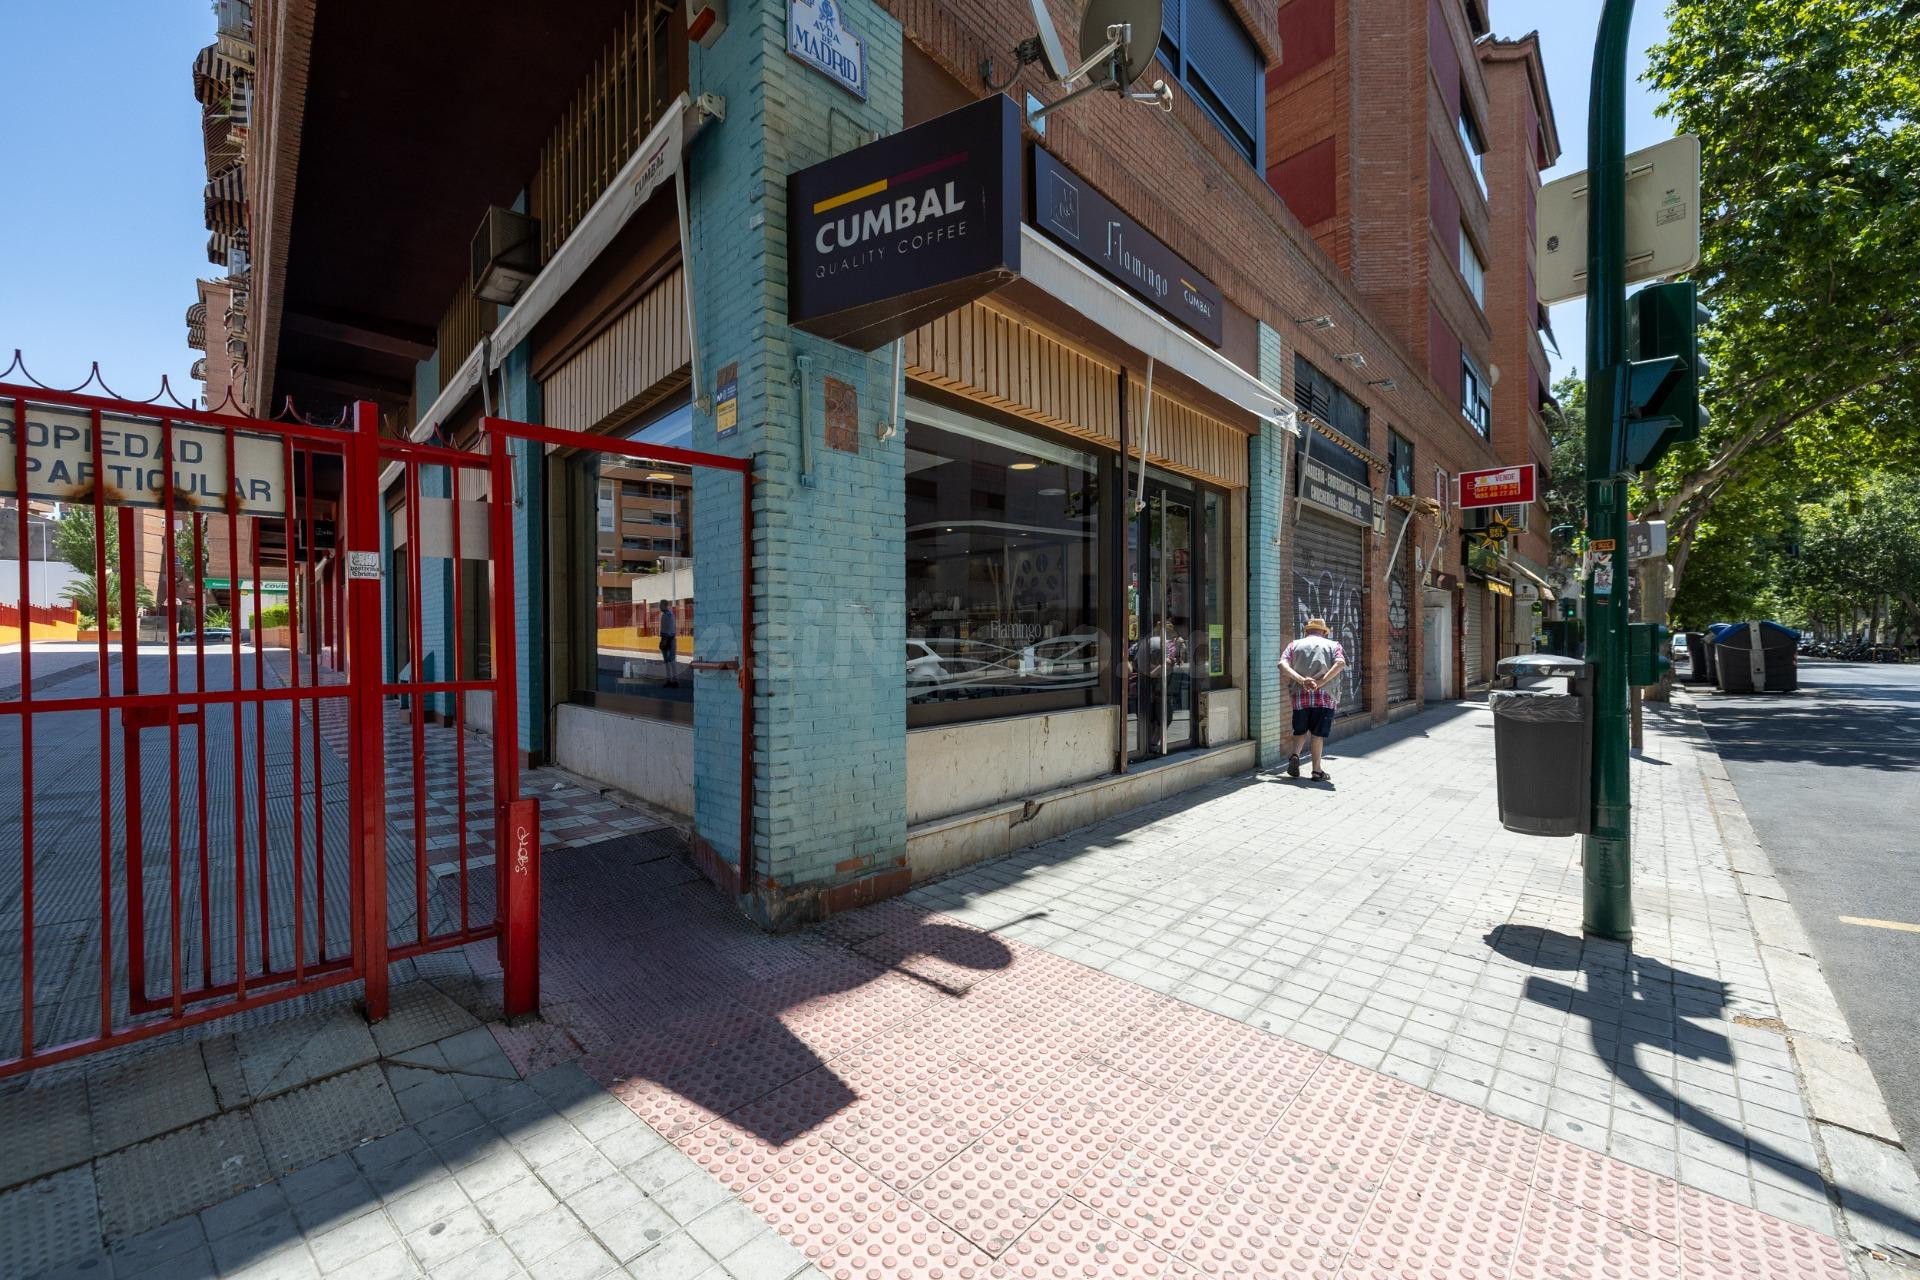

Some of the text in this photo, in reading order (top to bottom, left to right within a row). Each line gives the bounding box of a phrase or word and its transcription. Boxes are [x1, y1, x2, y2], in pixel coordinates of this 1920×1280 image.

[795, 24, 858, 83] MADRID
[822, 34, 833, 46] DE
[635, 152, 665, 197] CUMBAL
[815, 181, 966, 254] CUMBAL
[816, 221, 967, 279] QUALITY COFFEE
[1104, 221, 1169, 298] Flamingo
[1184, 289, 1211, 318] CUMBAL
[1495, 473, 1515, 482] VENDE
[990, 618, 1042, 643] Flamingo
